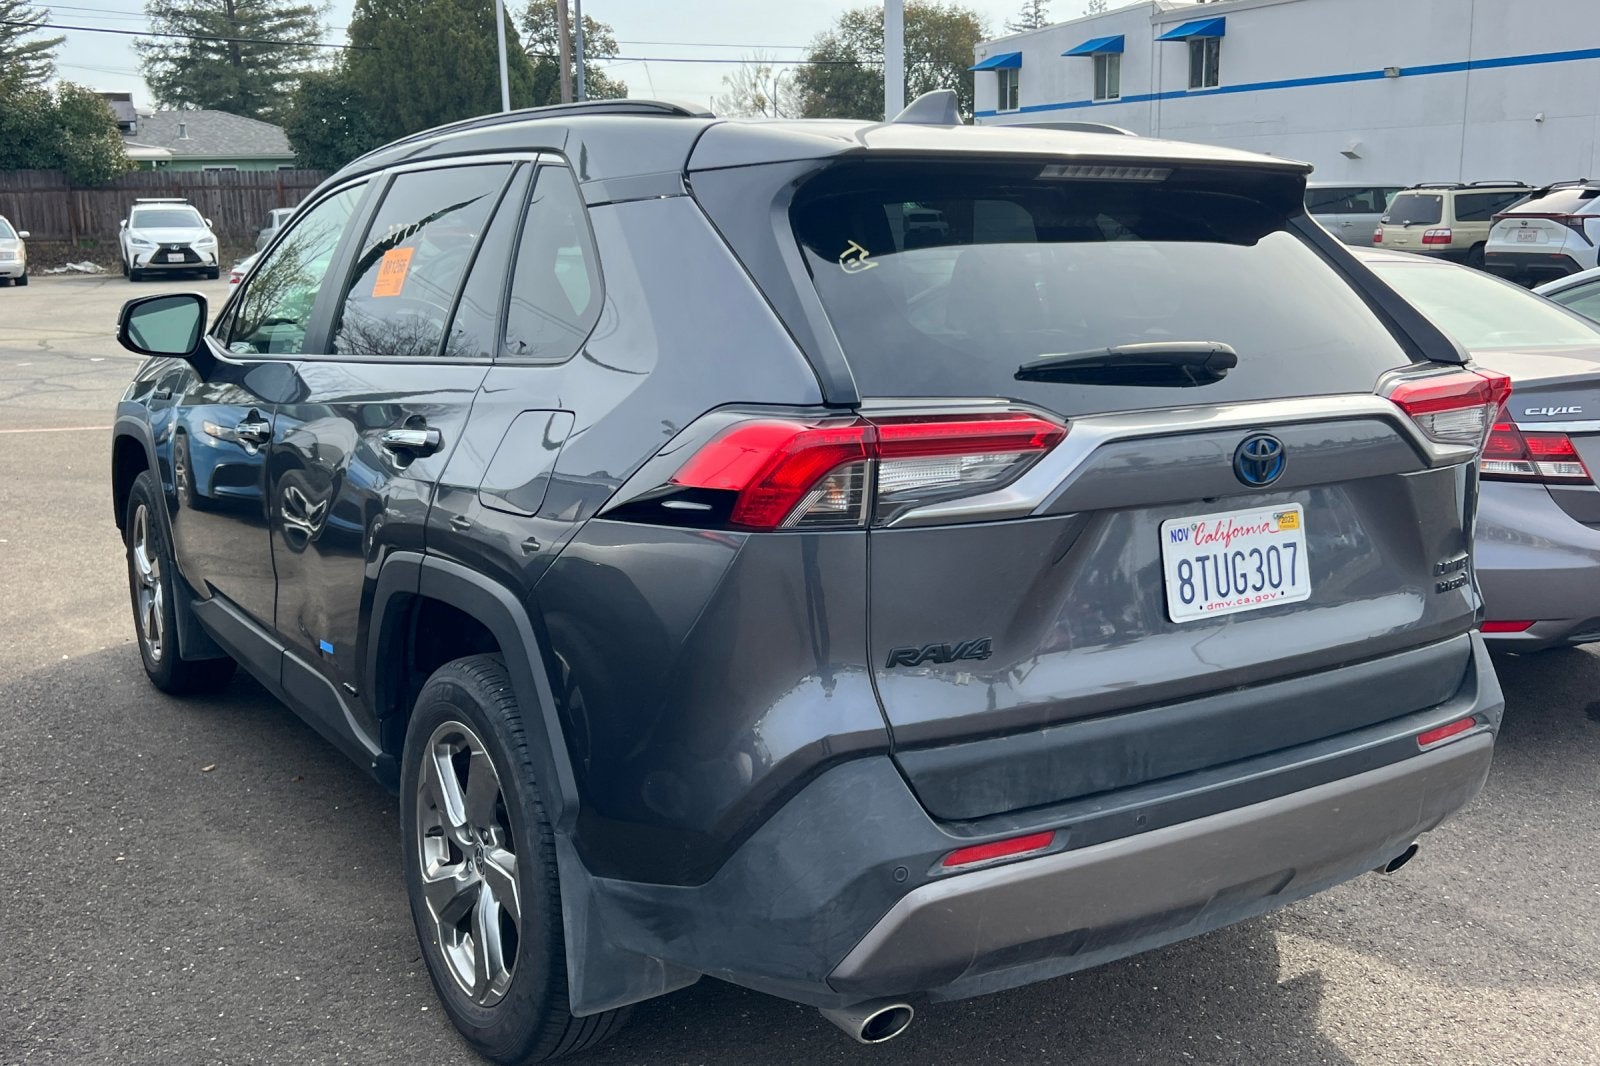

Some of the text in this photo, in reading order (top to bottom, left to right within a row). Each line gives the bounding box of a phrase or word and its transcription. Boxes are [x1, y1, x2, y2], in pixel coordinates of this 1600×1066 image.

[1525, 406, 1582, 416] CIVIC
[1170, 528, 1189, 543] NOV
[1194, 519, 1280, 548] California
[1177, 542, 1297, 604] 8TUG307
[1206, 592, 1277, 611] dmv.ca.gov
[885, 637, 993, 668] RAV4
